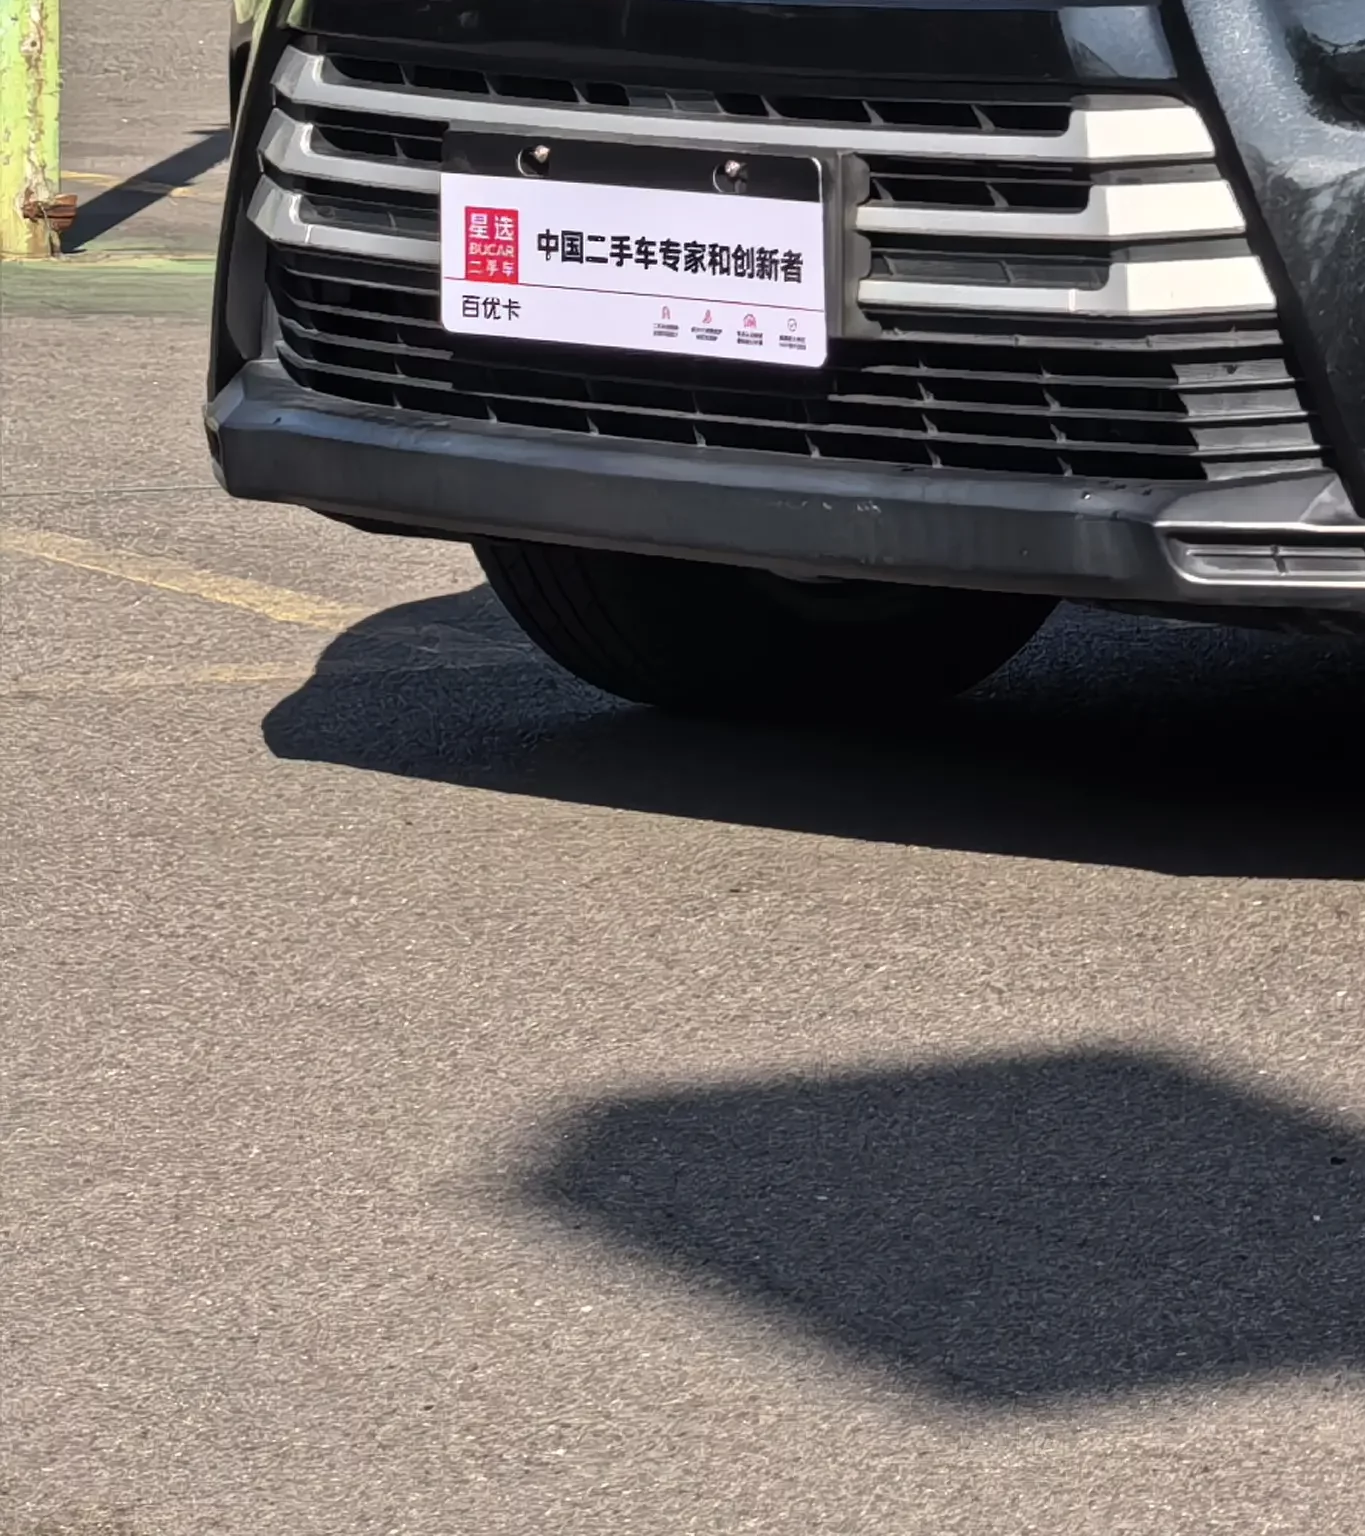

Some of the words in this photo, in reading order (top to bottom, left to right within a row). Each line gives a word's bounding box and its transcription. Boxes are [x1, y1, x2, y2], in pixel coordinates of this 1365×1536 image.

[468, 242, 515, 258] BUCAR
[537, 228, 804, 284] 中国二手车专家和创新者
[468, 259, 515, 277] 二手车
[461, 294, 522, 321] 百优卡
